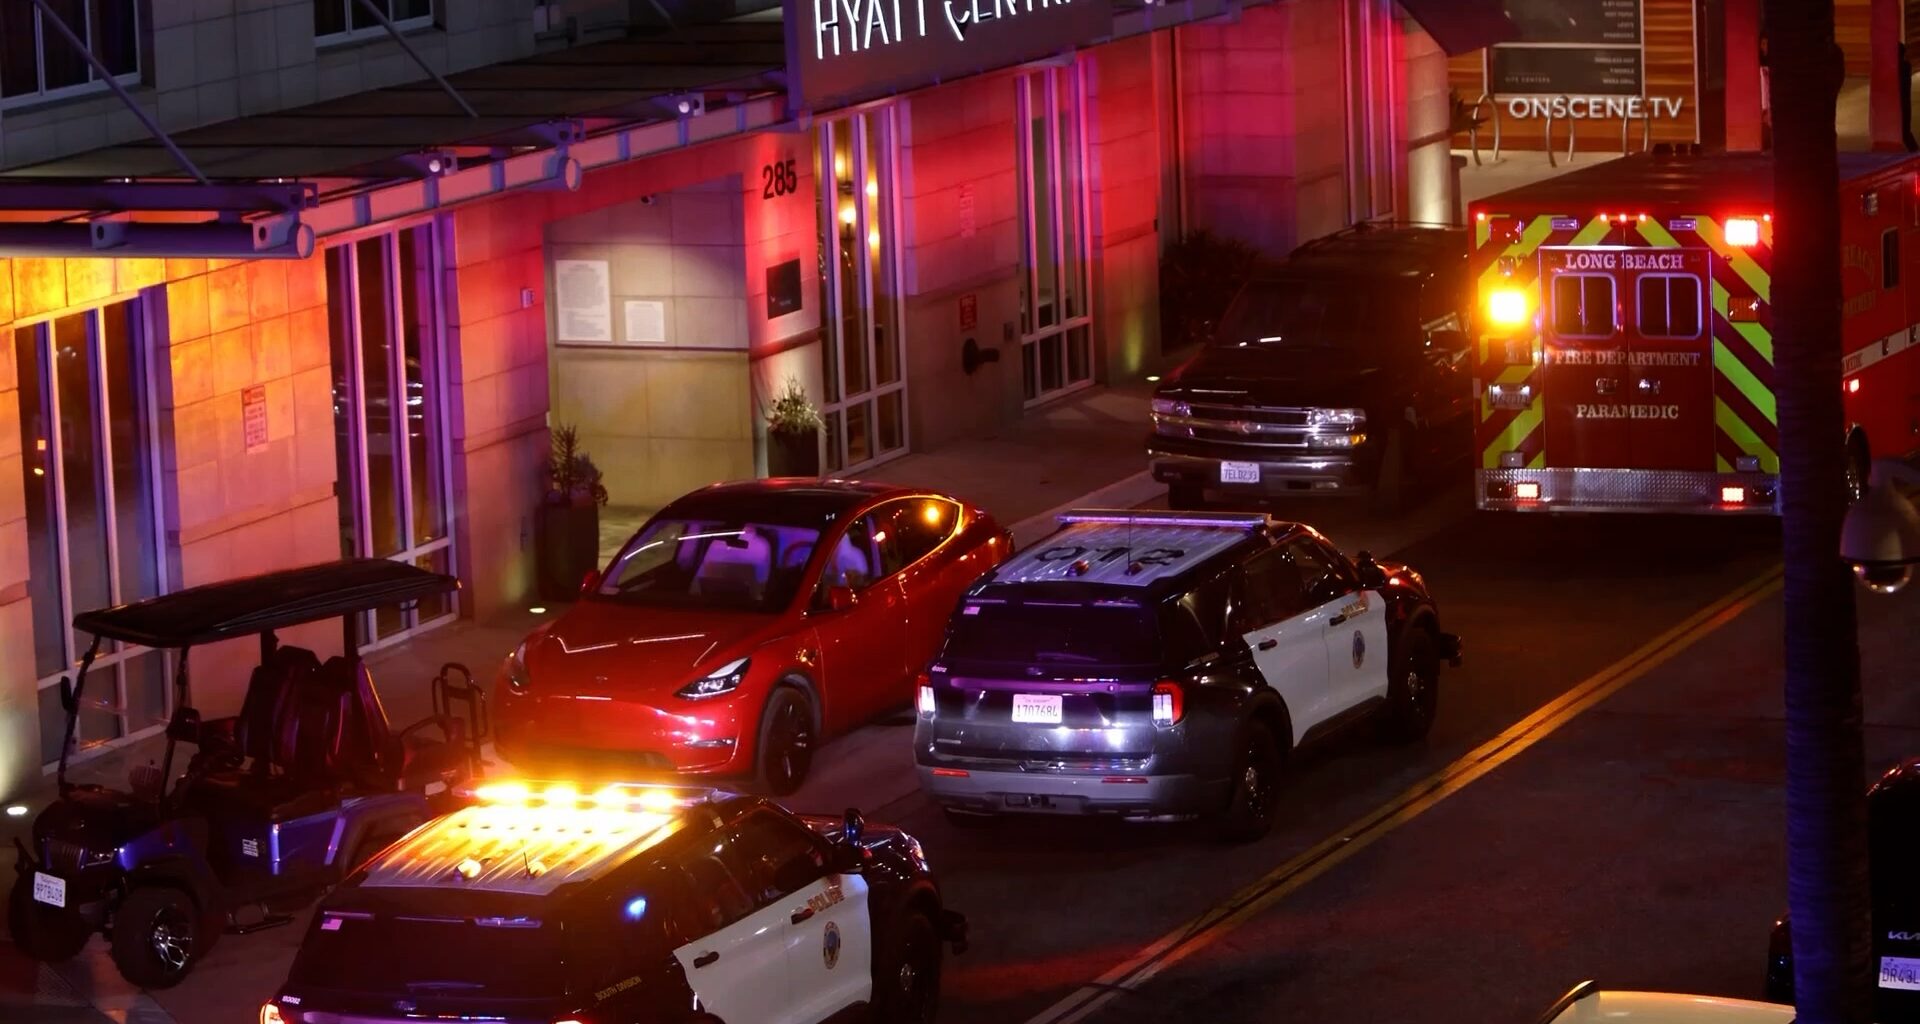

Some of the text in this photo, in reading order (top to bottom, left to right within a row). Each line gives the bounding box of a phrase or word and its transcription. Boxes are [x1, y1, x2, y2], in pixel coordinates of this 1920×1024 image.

[762, 160, 797, 199] 285
[1565, 253, 1684, 270] LONG BEACH
[1555, 350, 1700, 366] FIRE DEPARTMENT
[1577, 404, 1680, 419] PARAMEDIC
